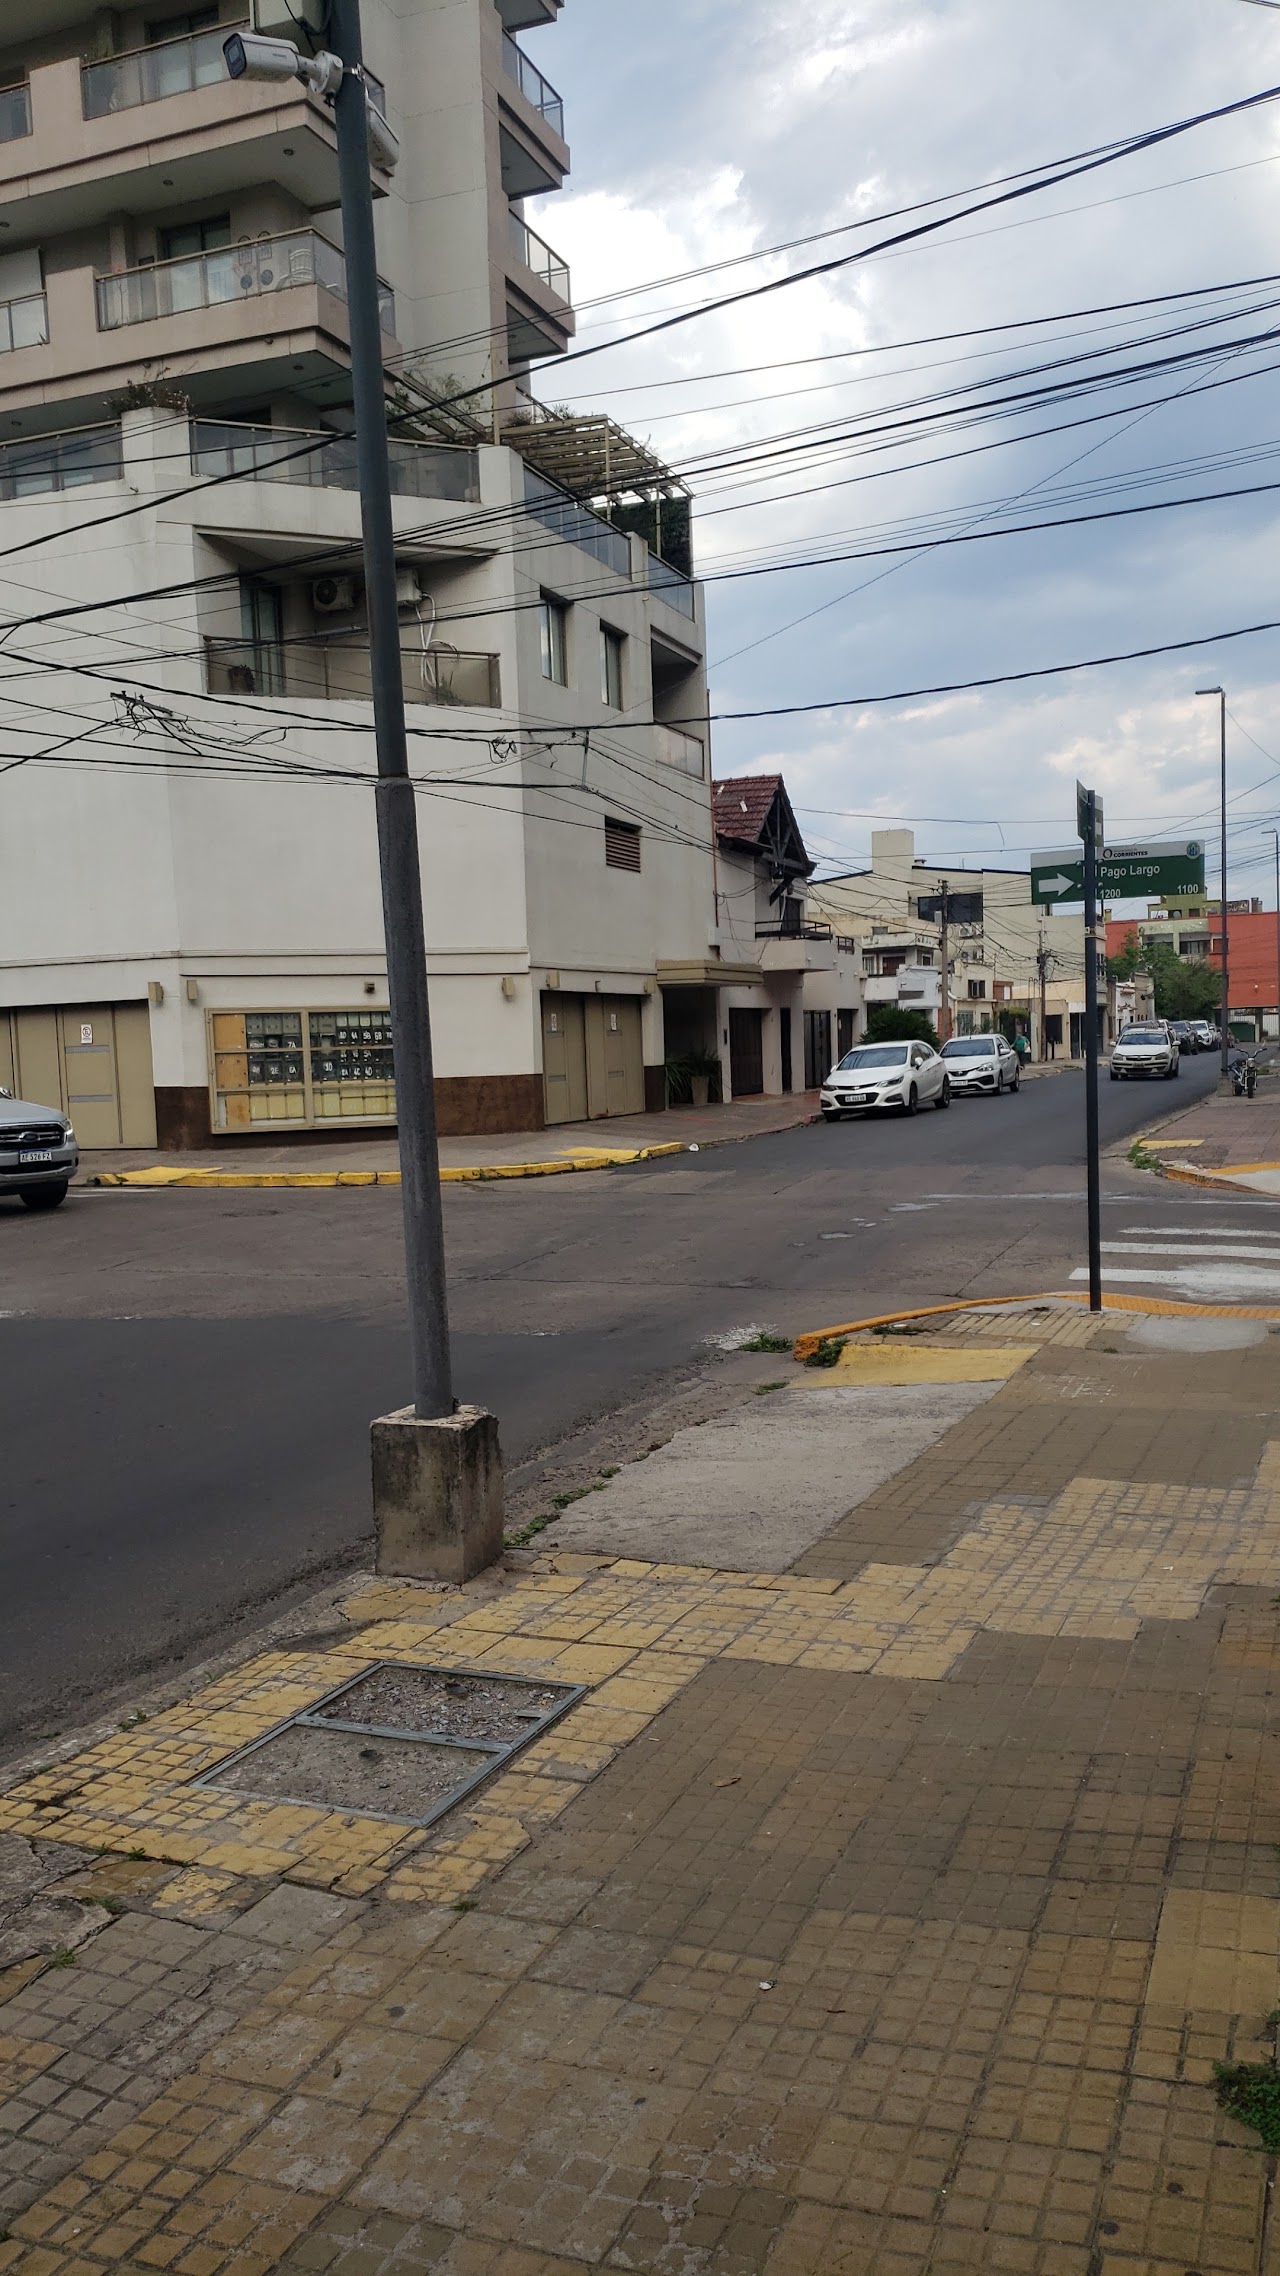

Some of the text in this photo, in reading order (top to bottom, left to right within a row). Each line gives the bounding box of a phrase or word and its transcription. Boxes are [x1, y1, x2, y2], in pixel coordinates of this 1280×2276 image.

[1100, 865, 1160, 879] Pago Largo
[1099, 888, 1121, 899] 1200
[1177, 884, 1199, 894] 1100
[287, 1041, 297, 1049] 7A
